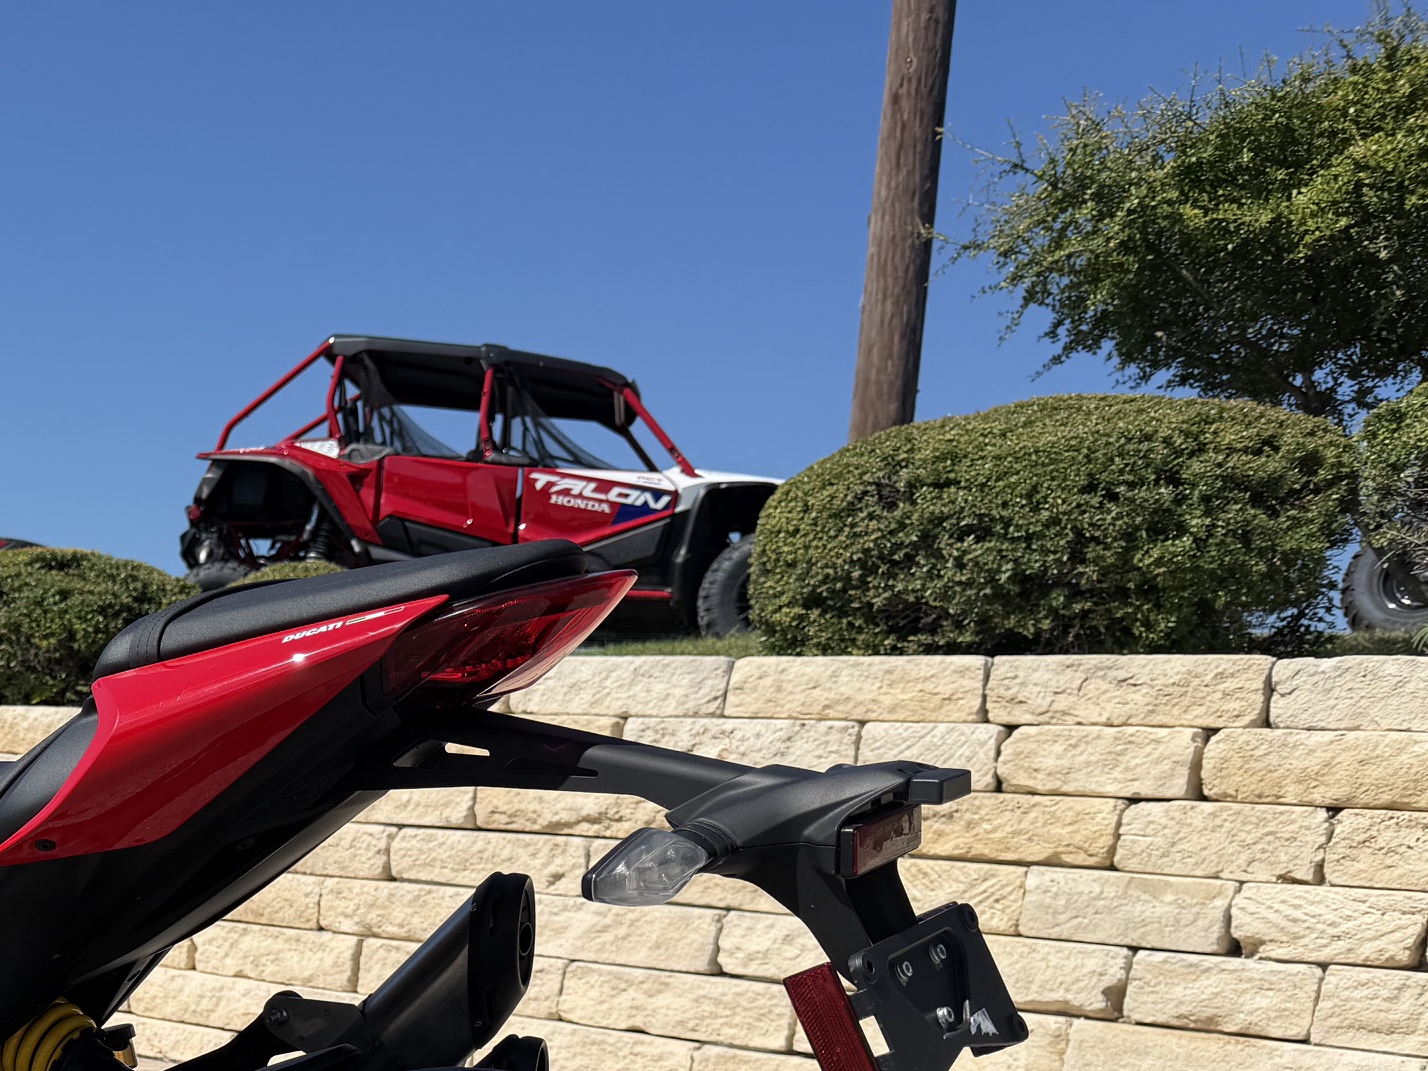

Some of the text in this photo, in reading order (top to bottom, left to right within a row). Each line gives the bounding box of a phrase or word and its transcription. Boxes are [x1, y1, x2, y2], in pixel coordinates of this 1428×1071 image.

[529, 472, 672, 511] TALON
[549, 494, 612, 514] HONDA
[281, 621, 344, 643] DUCATI
